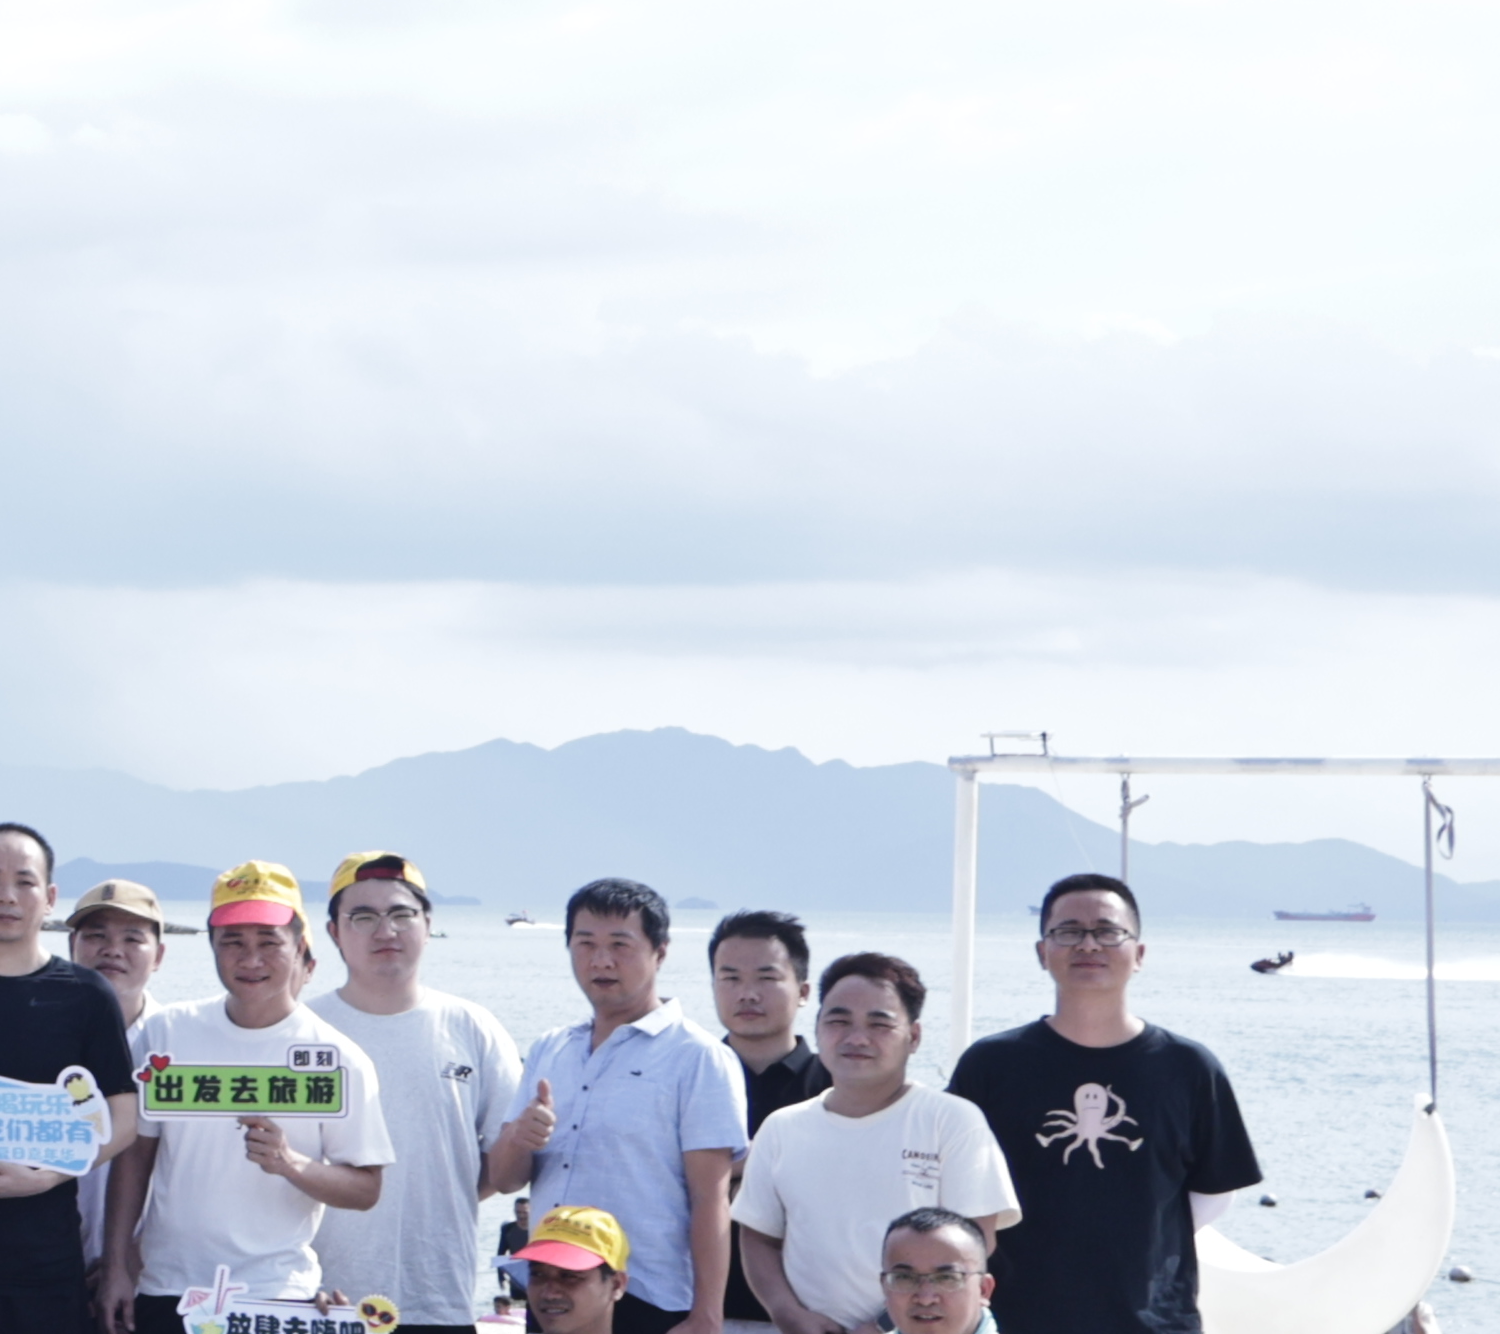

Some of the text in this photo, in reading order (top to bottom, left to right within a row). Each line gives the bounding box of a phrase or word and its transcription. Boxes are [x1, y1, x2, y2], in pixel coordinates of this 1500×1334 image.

[293, 1050, 333, 1067] 即刻
[155, 1075, 335, 1104] 出发去旅游
